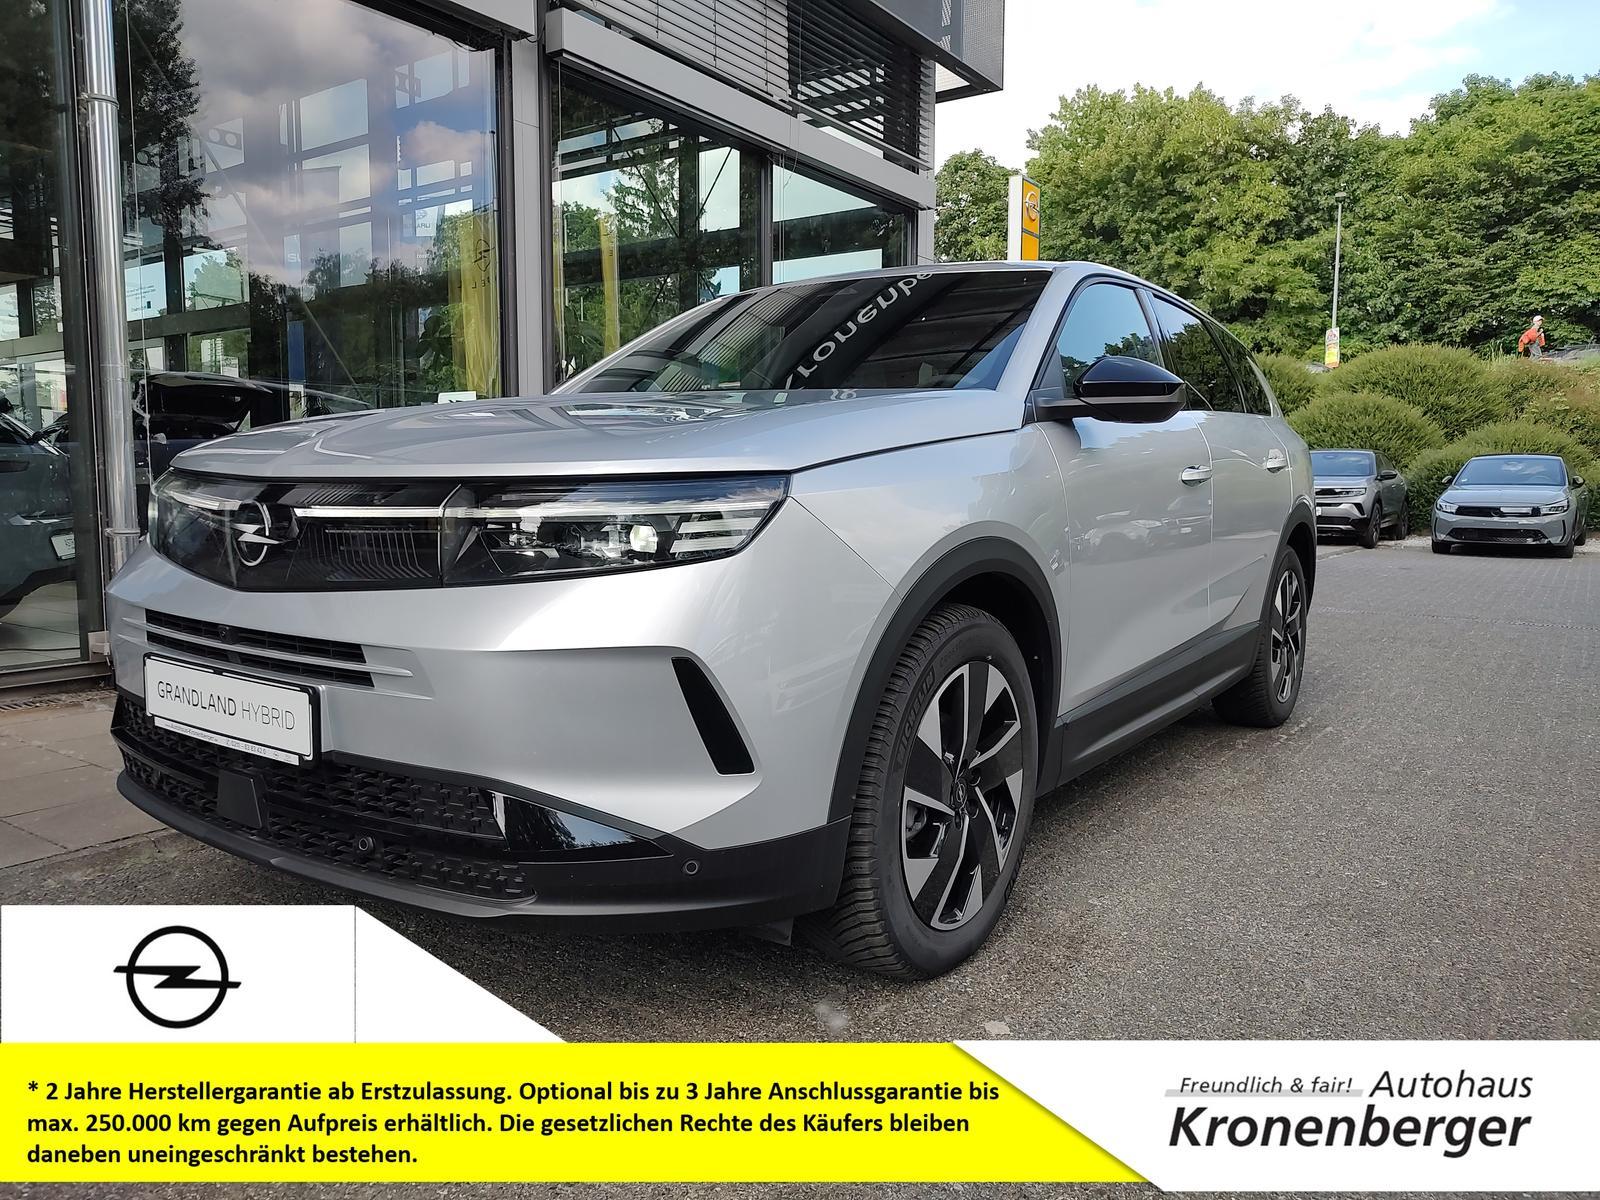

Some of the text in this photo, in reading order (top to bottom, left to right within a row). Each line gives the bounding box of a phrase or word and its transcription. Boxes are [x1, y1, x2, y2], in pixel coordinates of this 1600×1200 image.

[157, 680, 296, 730] GRANDLAND HYBRID
[896, 669, 935, 767] MICHELIN
